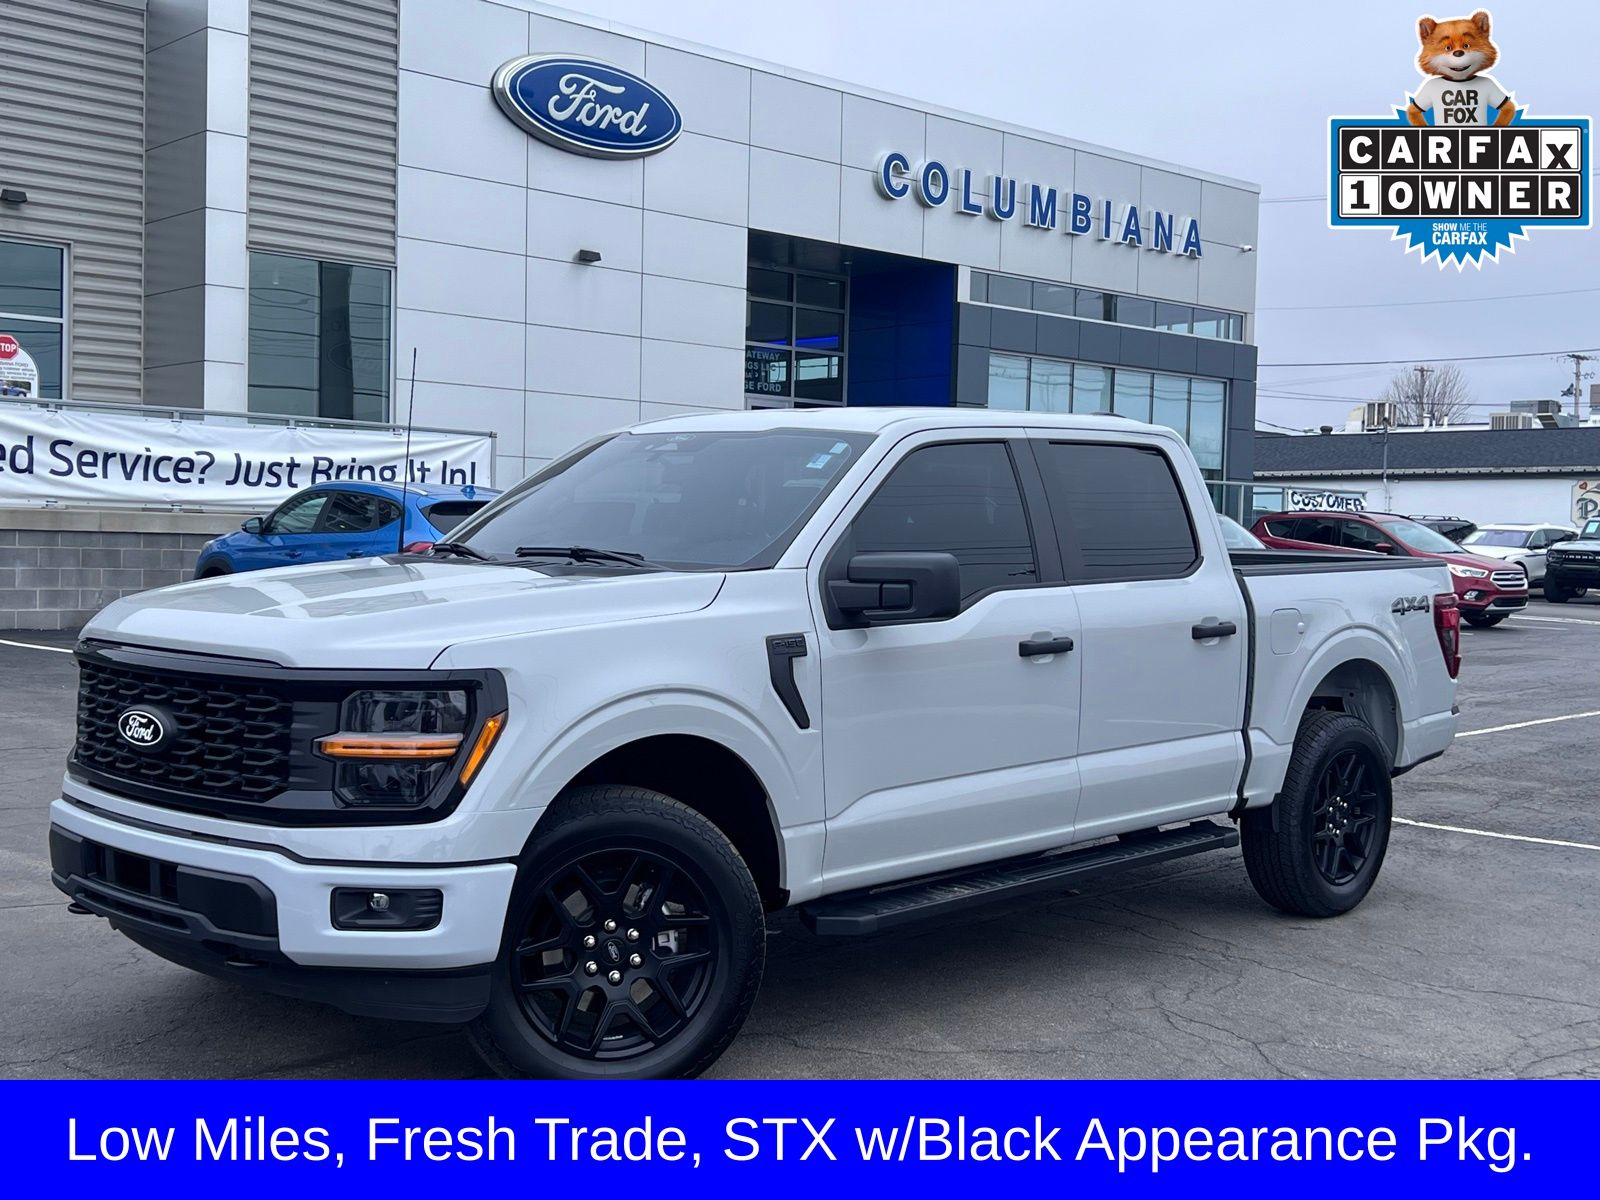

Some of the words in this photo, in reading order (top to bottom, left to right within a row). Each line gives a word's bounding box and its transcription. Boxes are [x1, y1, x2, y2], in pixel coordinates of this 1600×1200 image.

[548, 73, 650, 136] Ford
[878, 151, 1203, 258] COLUMBIANA
[0, 342, 17, 352] TOP
[745, 350, 780, 361] ATEWAY
[745, 361, 759, 371] GS
[757, 382, 781, 392] FORD
[49, 439, 216, 485] Service?
[226, 452, 301, 488] Just
[409, 459, 431, 483] It
[1291, 491, 1364, 512] CUSTOMER
[125, 715, 154, 741] Ford
